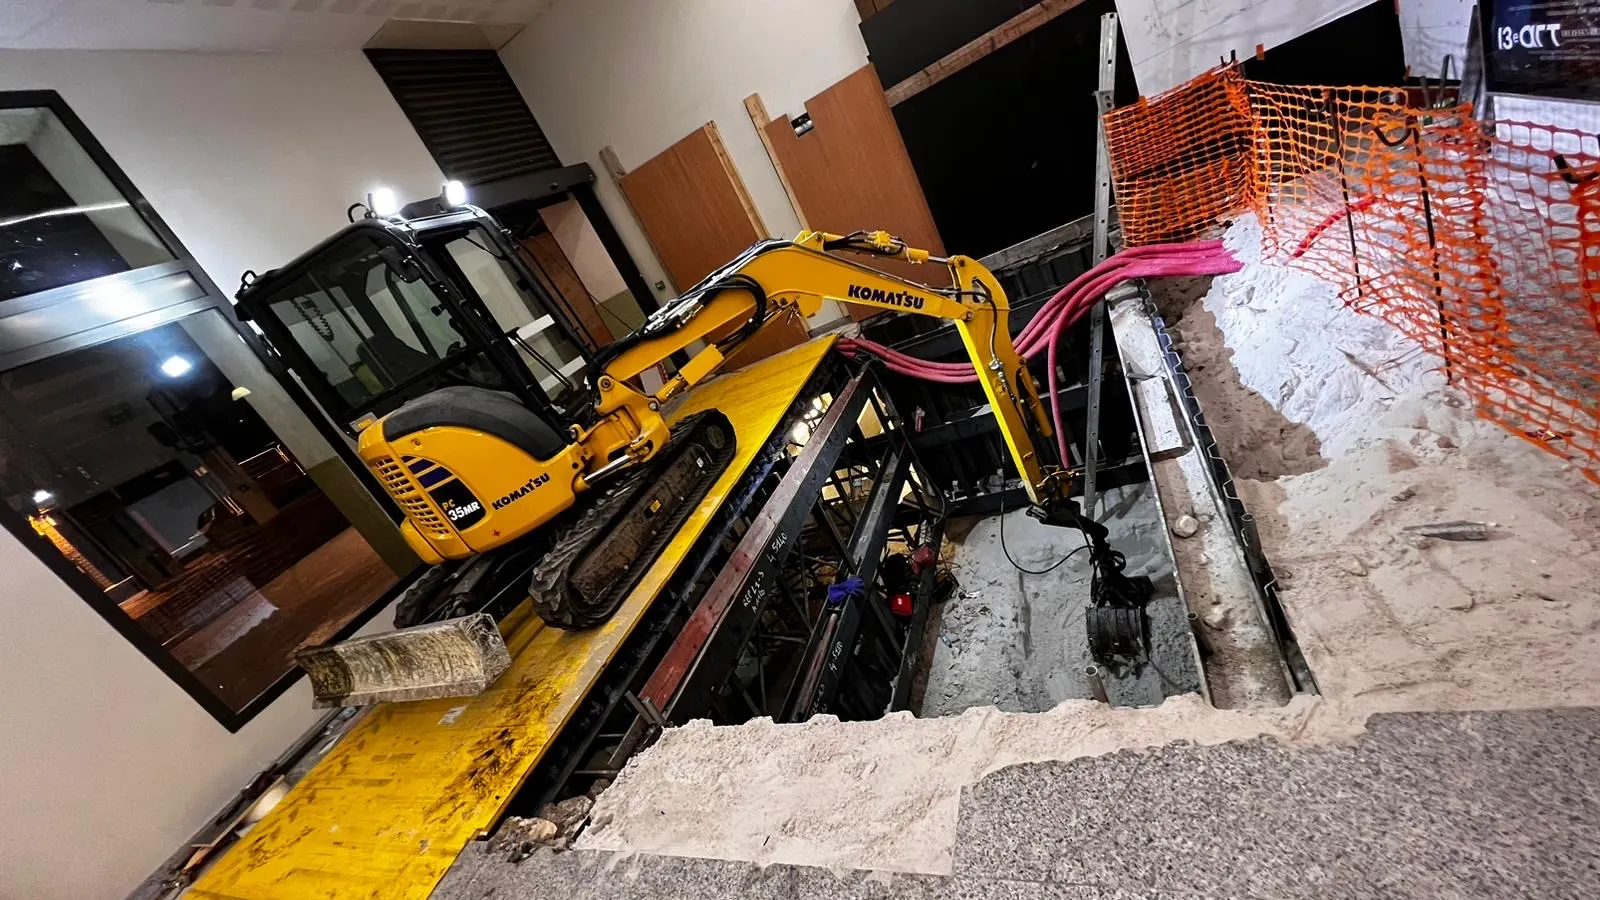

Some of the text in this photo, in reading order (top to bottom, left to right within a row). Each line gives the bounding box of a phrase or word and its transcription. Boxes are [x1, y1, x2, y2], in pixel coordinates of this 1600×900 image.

[848, 284, 924, 309] KOMATSU
[492, 473, 550, 510] KOMATSU
[442, 498, 456, 511] PC
[448, 501, 480, 521] 35MR
